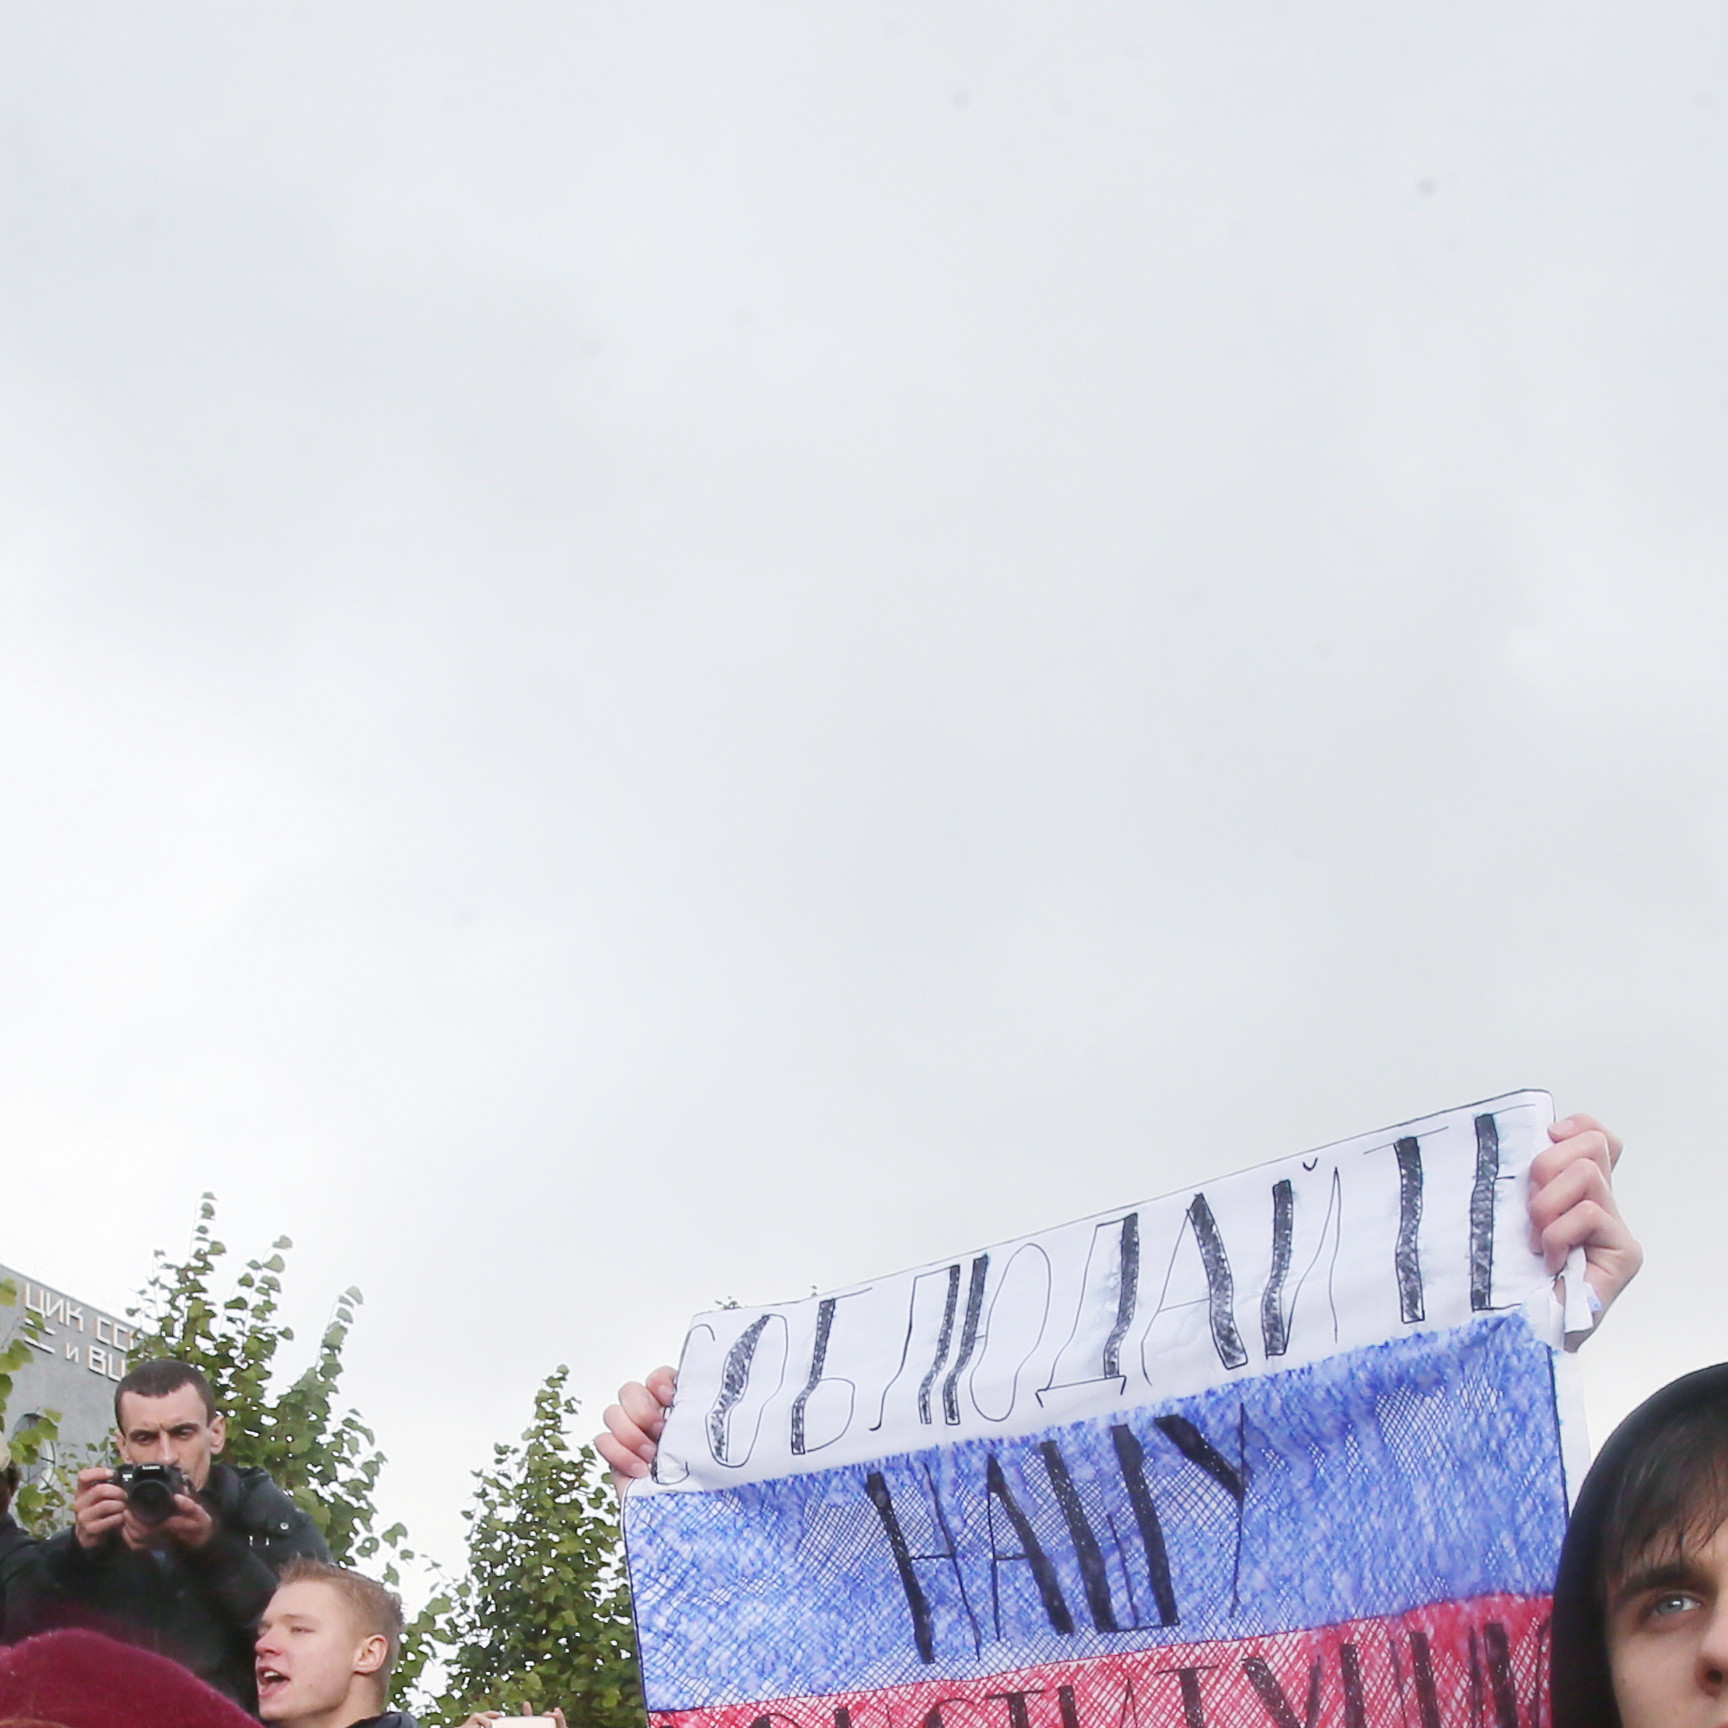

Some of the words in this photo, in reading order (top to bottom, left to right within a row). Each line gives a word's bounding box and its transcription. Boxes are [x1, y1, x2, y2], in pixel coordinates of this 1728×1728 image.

[24, 1282, 84, 1333] ЦИК
[651, 1104, 1536, 1485] СОБЛЮДАЙТЕ
[867, 1402, 1247, 1664] НАШУ
